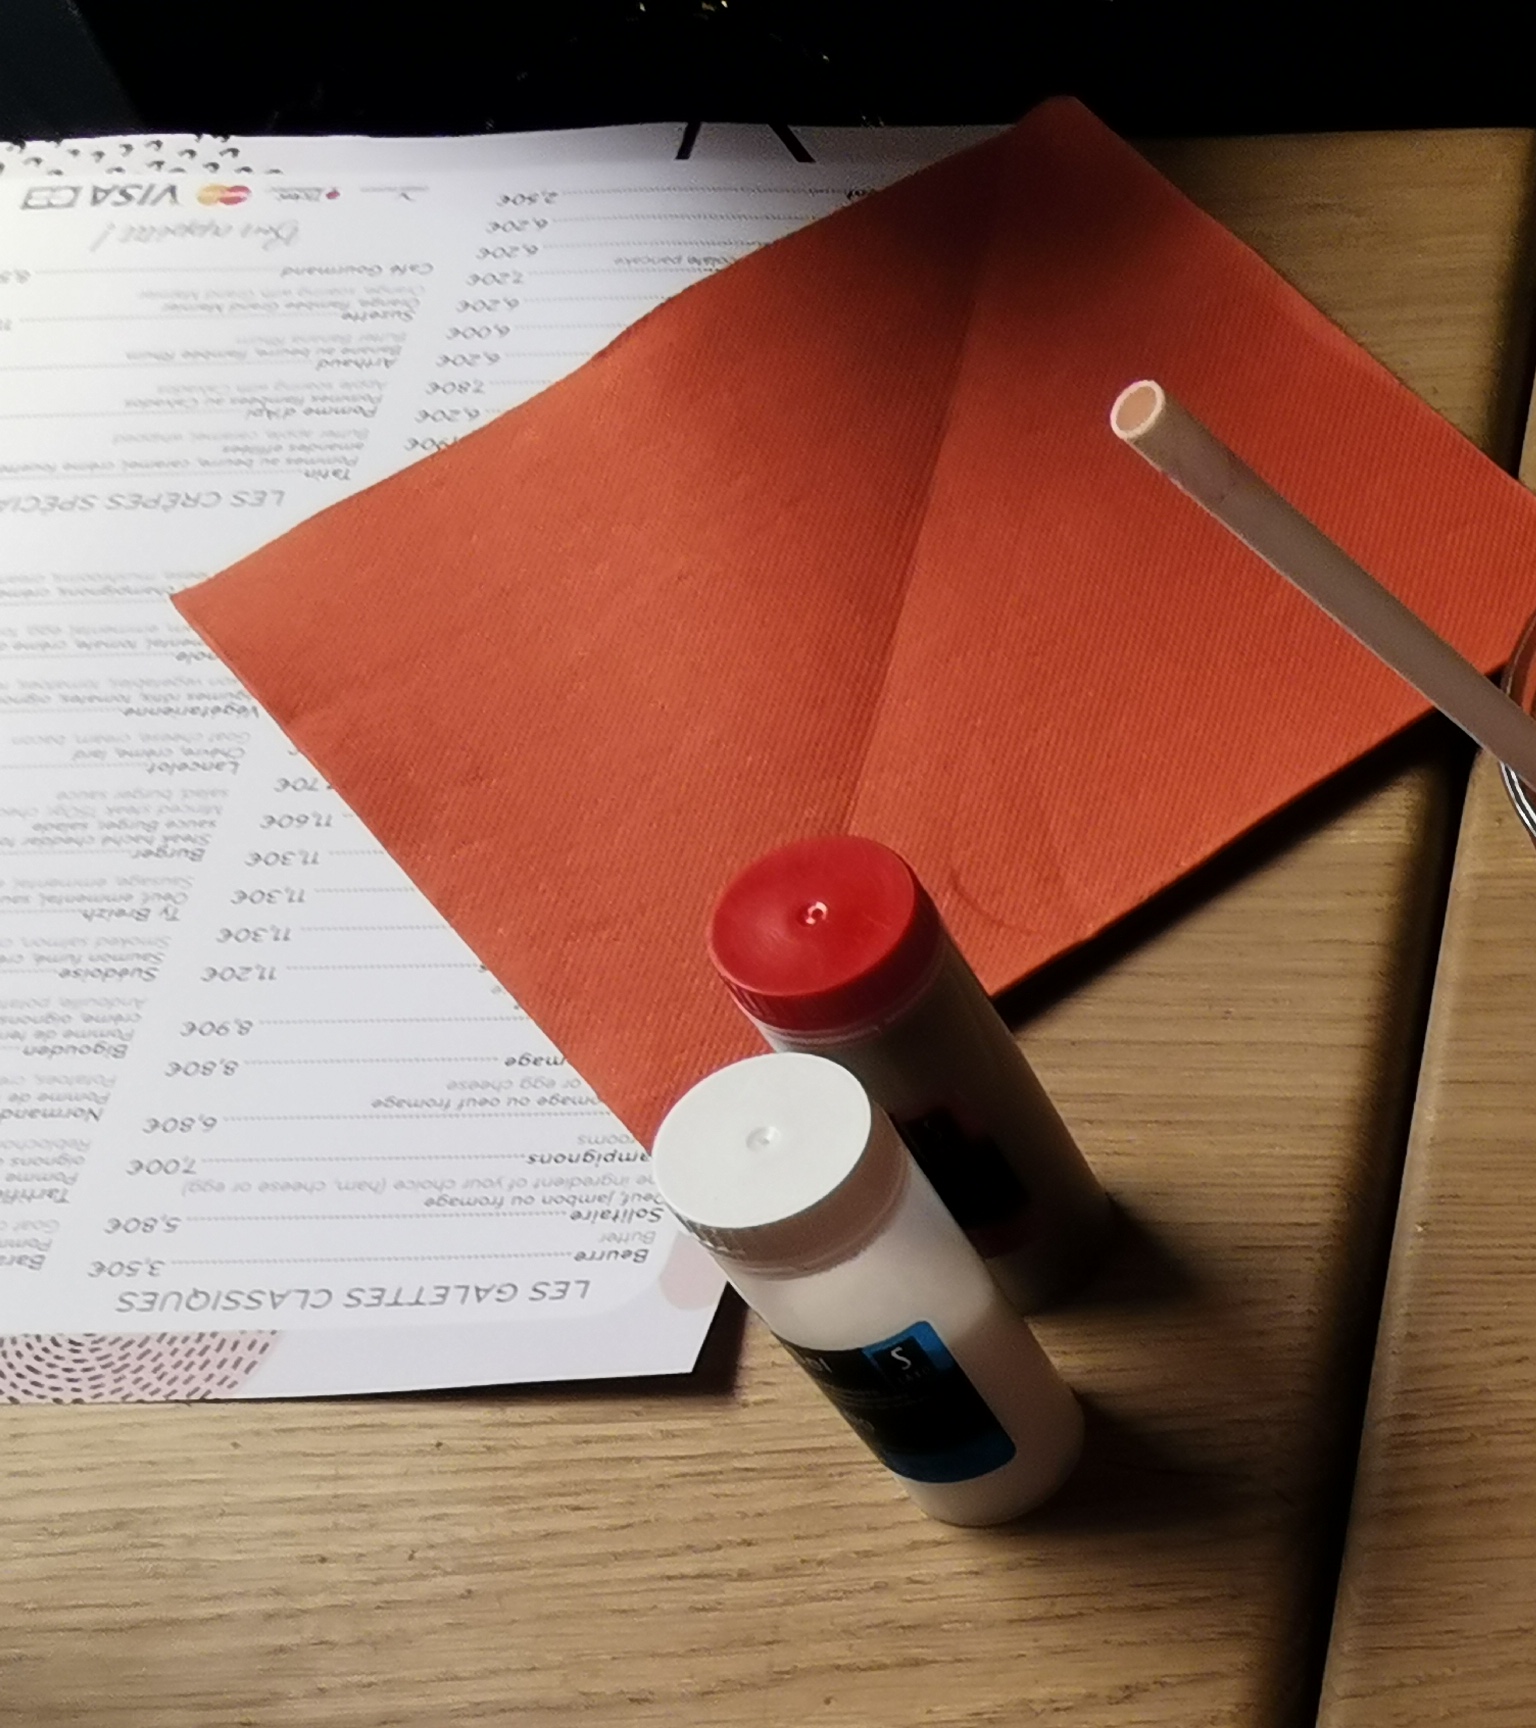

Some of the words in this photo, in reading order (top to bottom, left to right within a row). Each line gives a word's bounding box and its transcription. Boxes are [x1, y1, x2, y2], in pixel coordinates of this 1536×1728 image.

[574, 1249, 649, 1263] Beurre
[116, 1288, 332, 1312] CLASSIQUES
[343, 1283, 518, 1308] GALETTES
[529, 1280, 590, 1301] LES
